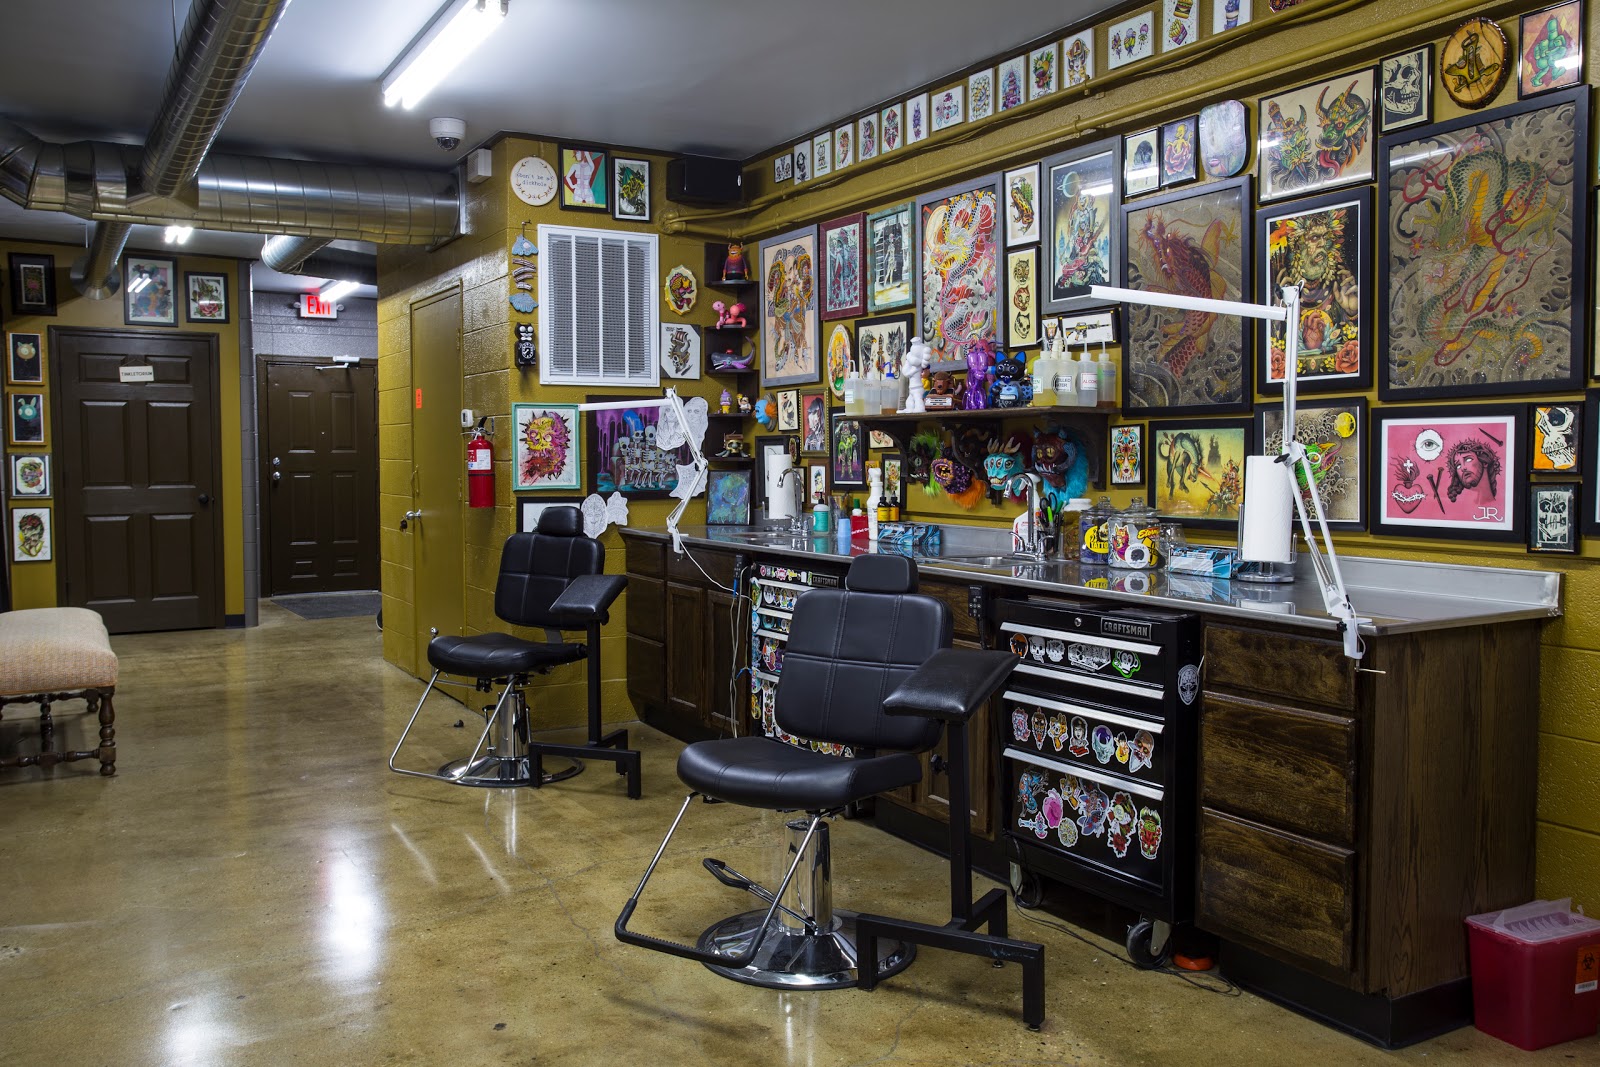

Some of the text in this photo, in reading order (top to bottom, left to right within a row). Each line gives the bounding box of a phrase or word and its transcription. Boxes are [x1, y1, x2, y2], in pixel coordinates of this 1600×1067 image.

[1472, 506, 1504, 522] JR
[1089, 541, 1109, 549] TATTO
[1104, 621, 1148, 637] CRAFTSMAN
